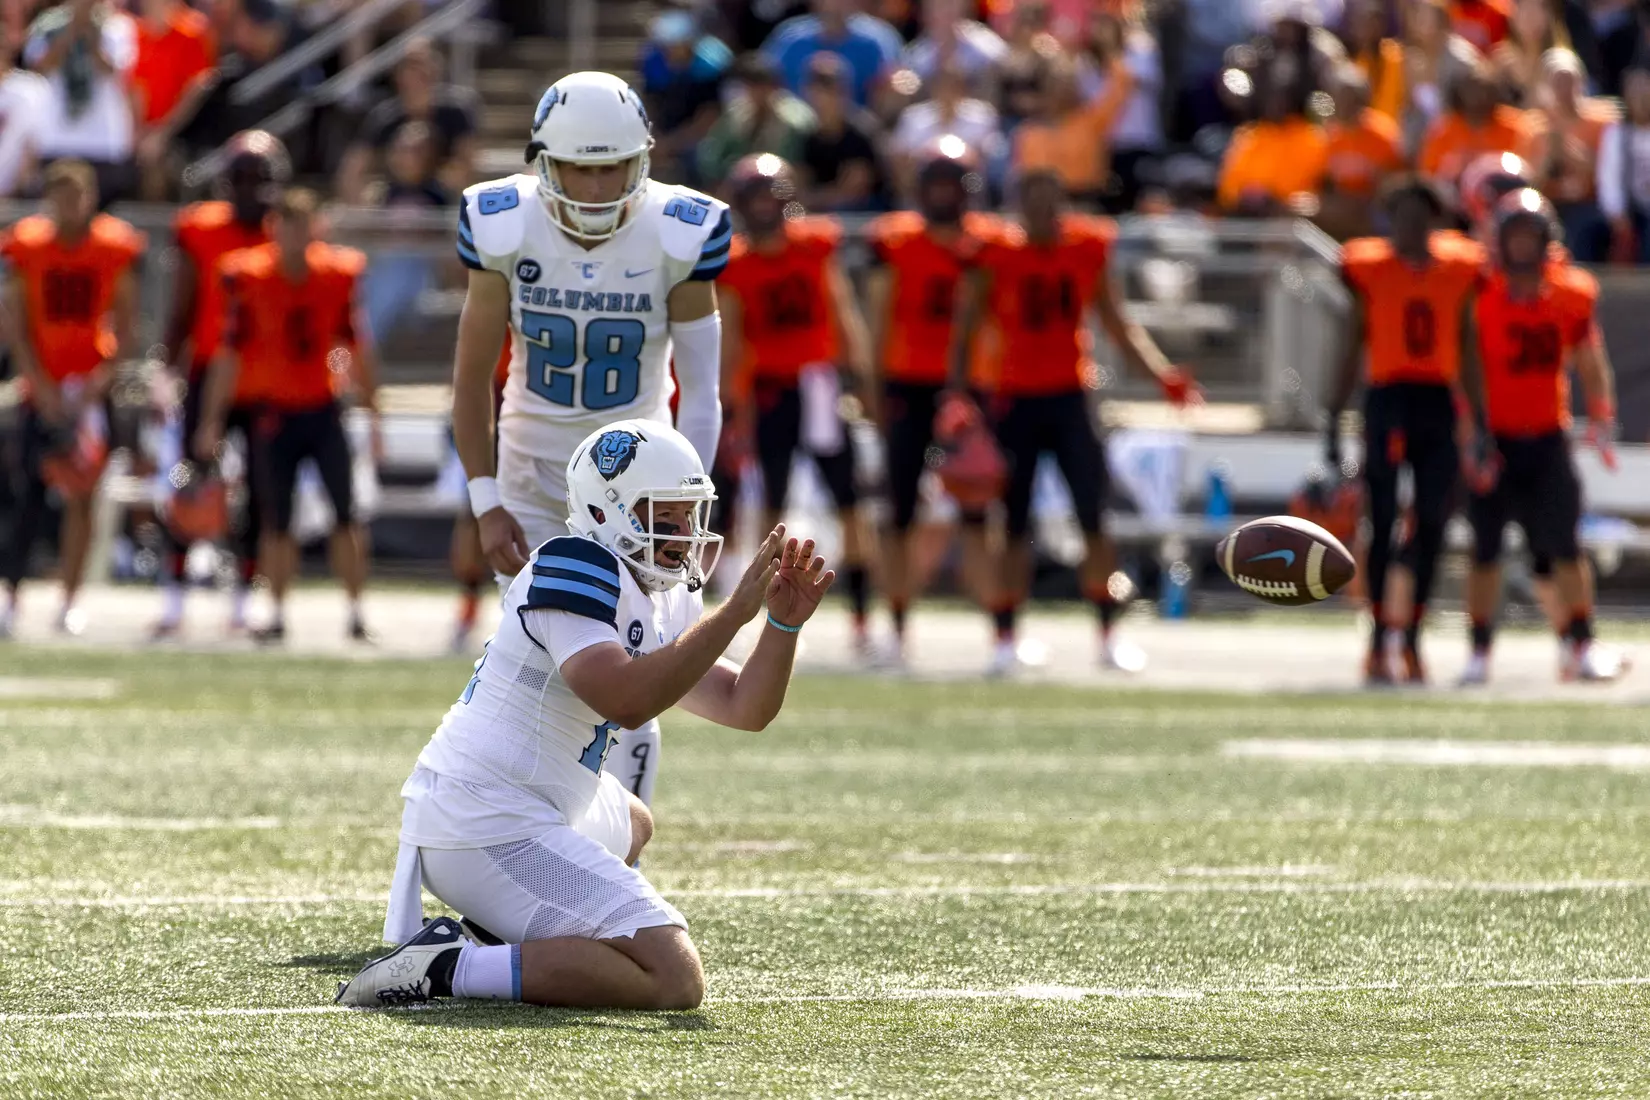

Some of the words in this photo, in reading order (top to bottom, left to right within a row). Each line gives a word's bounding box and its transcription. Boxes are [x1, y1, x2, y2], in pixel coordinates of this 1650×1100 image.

[518, 284, 652, 313] COLUMBIA
[520, 308, 646, 410] 28
[630, 626, 642, 642] 67
